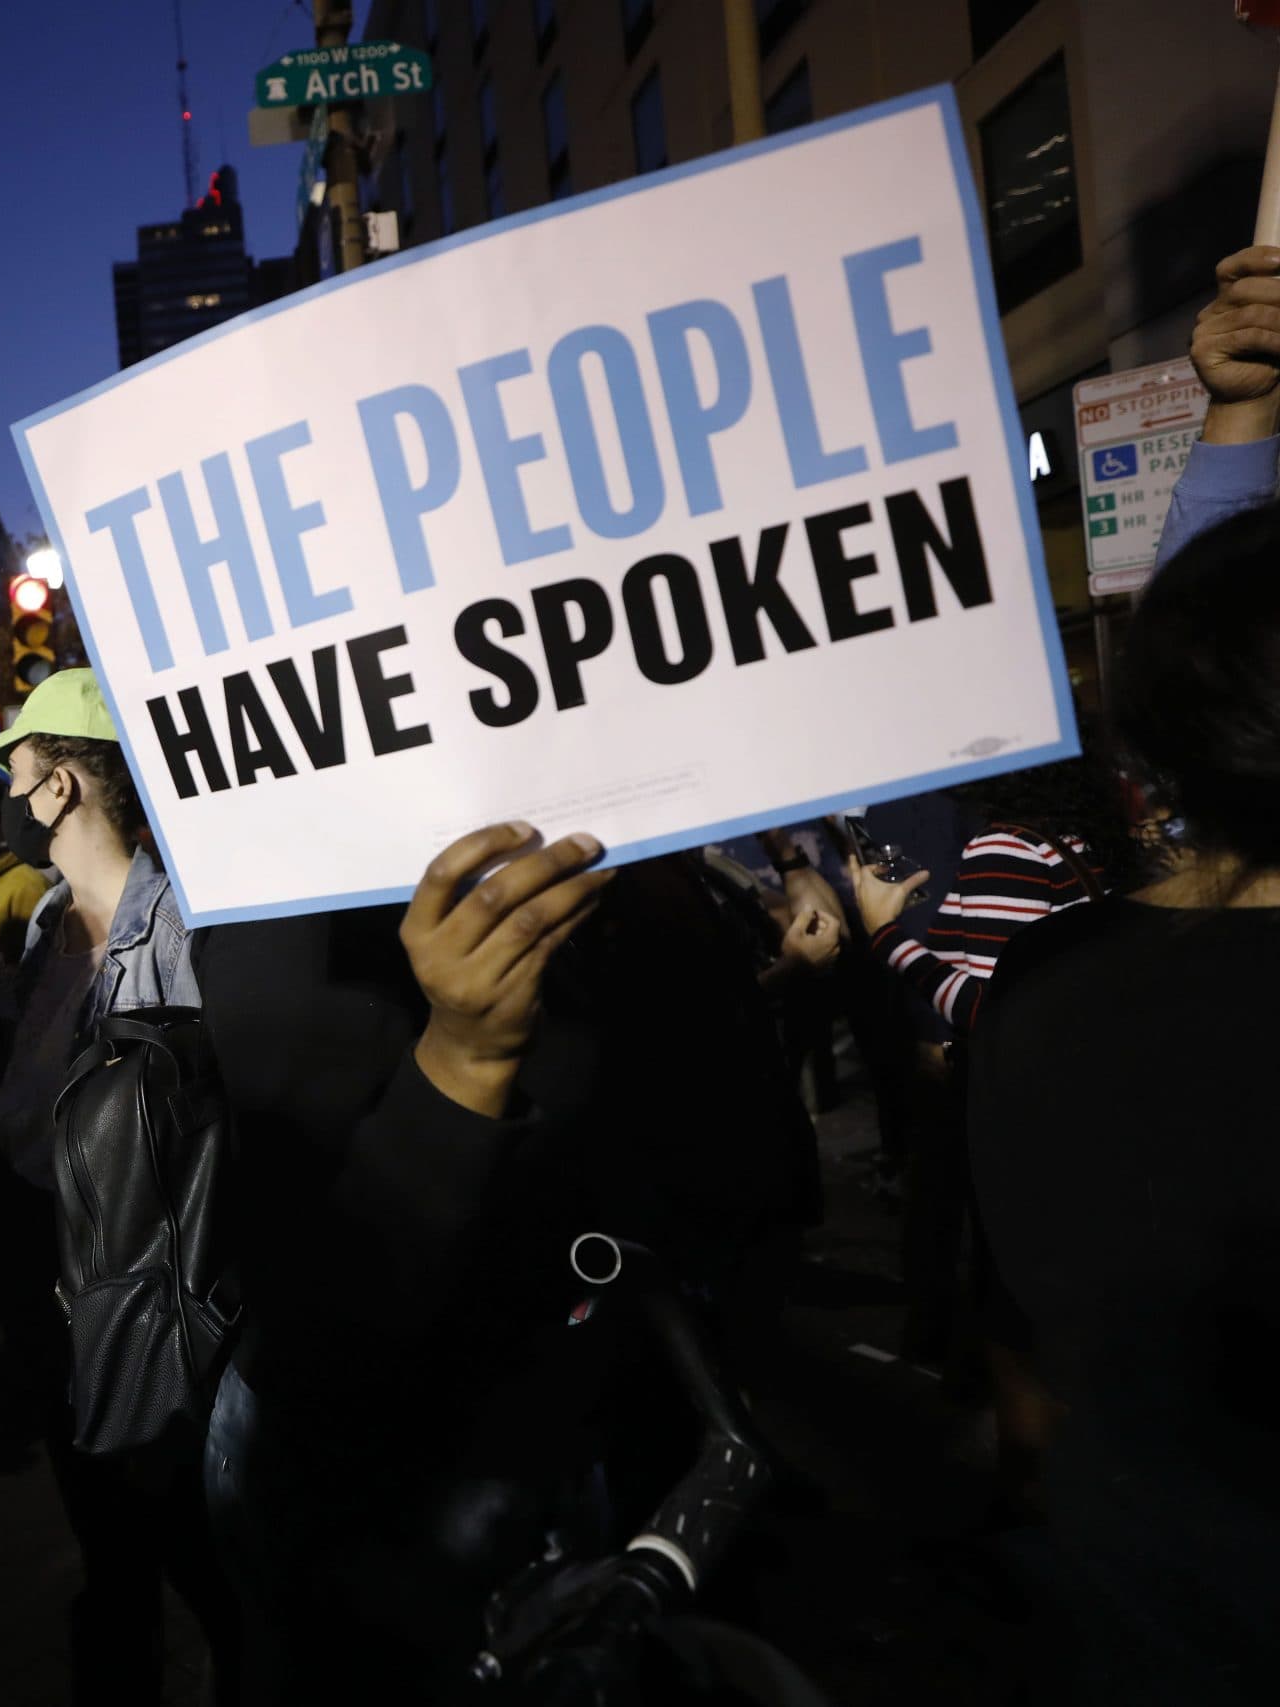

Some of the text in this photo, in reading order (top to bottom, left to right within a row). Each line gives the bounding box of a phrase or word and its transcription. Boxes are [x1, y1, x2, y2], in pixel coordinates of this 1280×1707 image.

[297, 45, 388, 65] 1100 W 1200
[305, 62, 423, 100] Arch St
[1081, 405, 1108, 426] NO
[1116, 384, 1207, 415] STOPPIN
[85, 236, 961, 674] THE PEOPLE
[145, 475, 995, 801] HAVE SPOKEN
